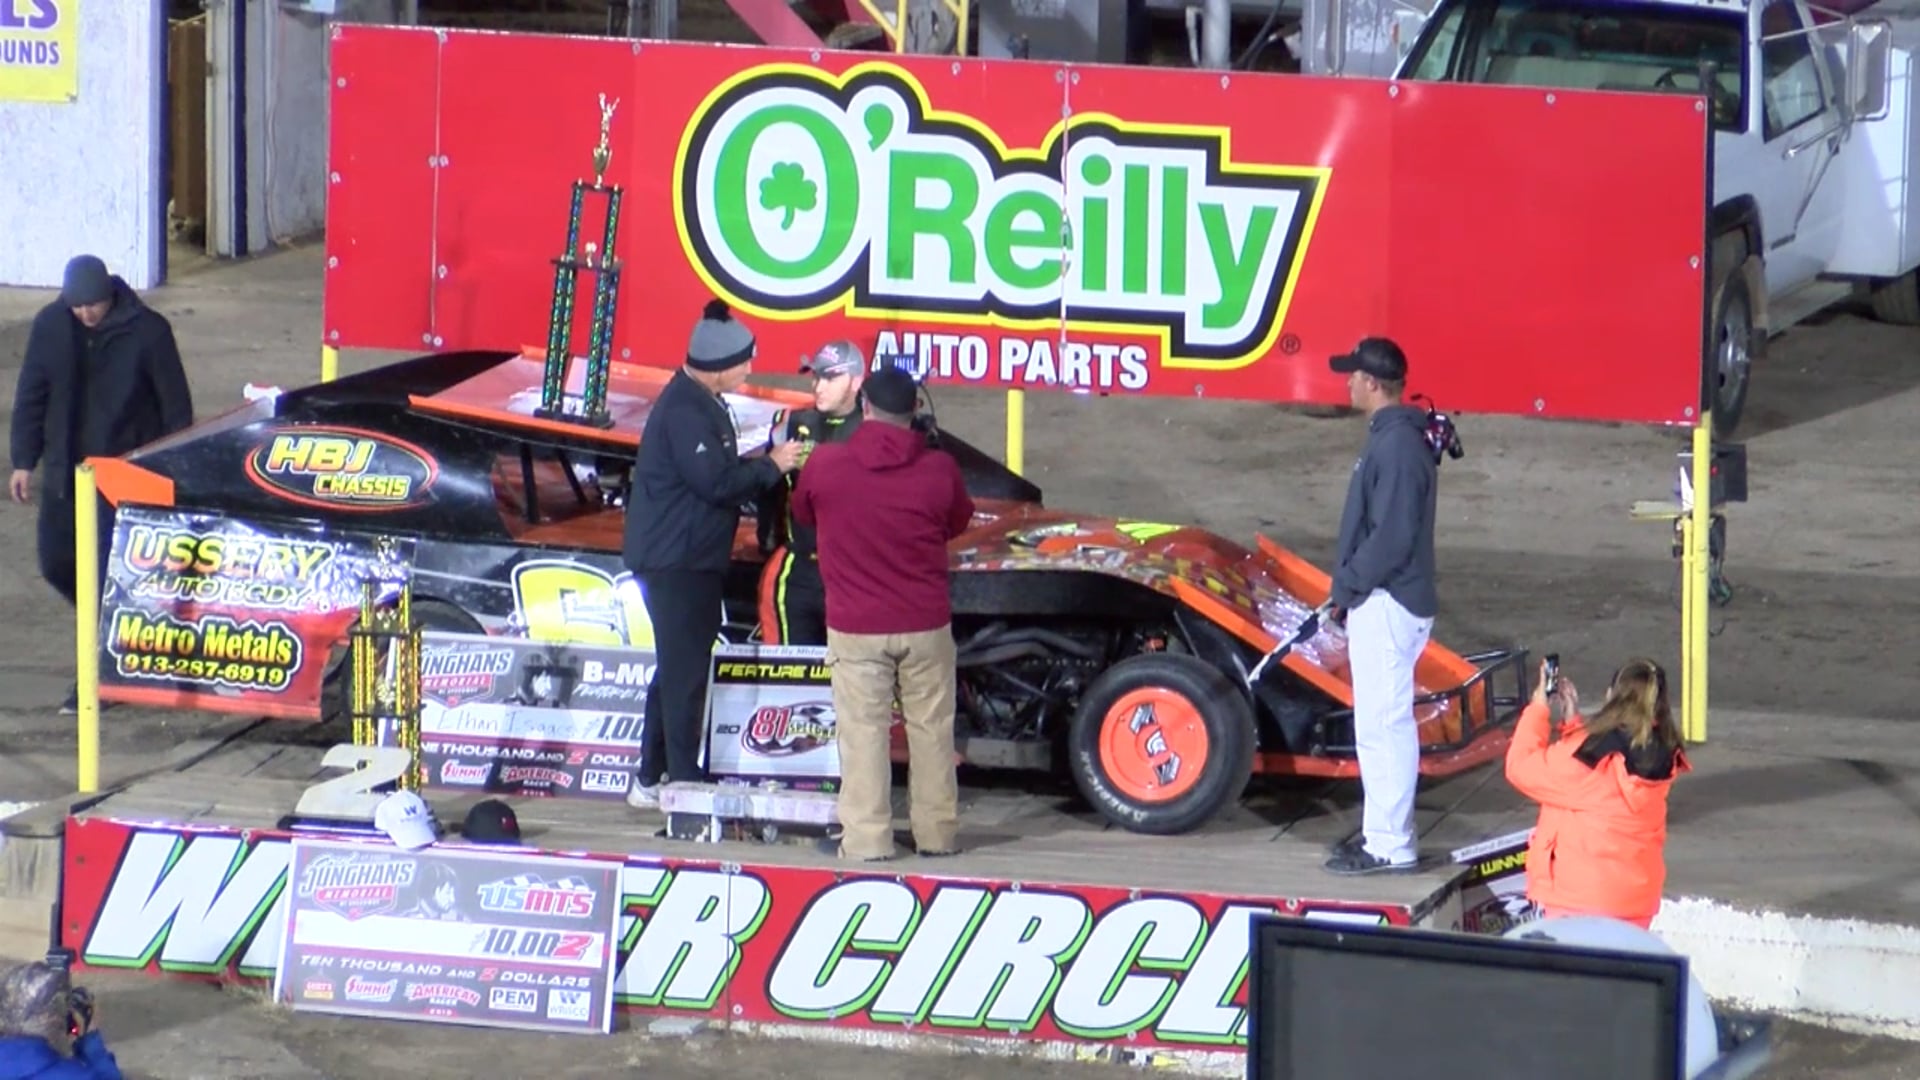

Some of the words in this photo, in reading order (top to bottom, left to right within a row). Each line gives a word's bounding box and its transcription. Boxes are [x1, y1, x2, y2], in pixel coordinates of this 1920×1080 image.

[0, 39, 60, 65] UNDS
[714, 102, 1279, 329] O'Reilly
[871, 331, 988, 380] AUTO
[1000, 337, 1149, 389] PARTS
[266, 436, 375, 474] HBJ
[314, 474, 411, 500] CHASSIS
[130, 533, 330, 582] USSERY
[138, 574, 220, 597] AUTO
[117, 614, 195, 651] Metro
[203, 622, 292, 667] Metals
[124, 654, 284, 685] 913-287-6919
[421, 650, 514, 676] NGHANS
[718, 663, 808, 679] FEATURE
[752, 706, 792, 742] 81
[442, 743, 535, 760] THOUSAND
[535, 752, 565, 762] AND
[295, 743, 411, 817] 2
[505, 766, 573, 788] AMERICAN
[584, 771, 627, 788] PEM
[1480, 850, 1529, 877] WINNE
[479, 885, 595, 917] USMTS
[301, 955, 334, 967] TEN
[340, 957, 442, 976] THOUSAND
[447, 969, 476, 979] AND
[500, 971, 591, 988] DOLLARS
[766, 876, 1389, 1045] CIRCL
[412, 983, 481, 1006] AMERICAN
[492, 989, 536, 1006] PEM
